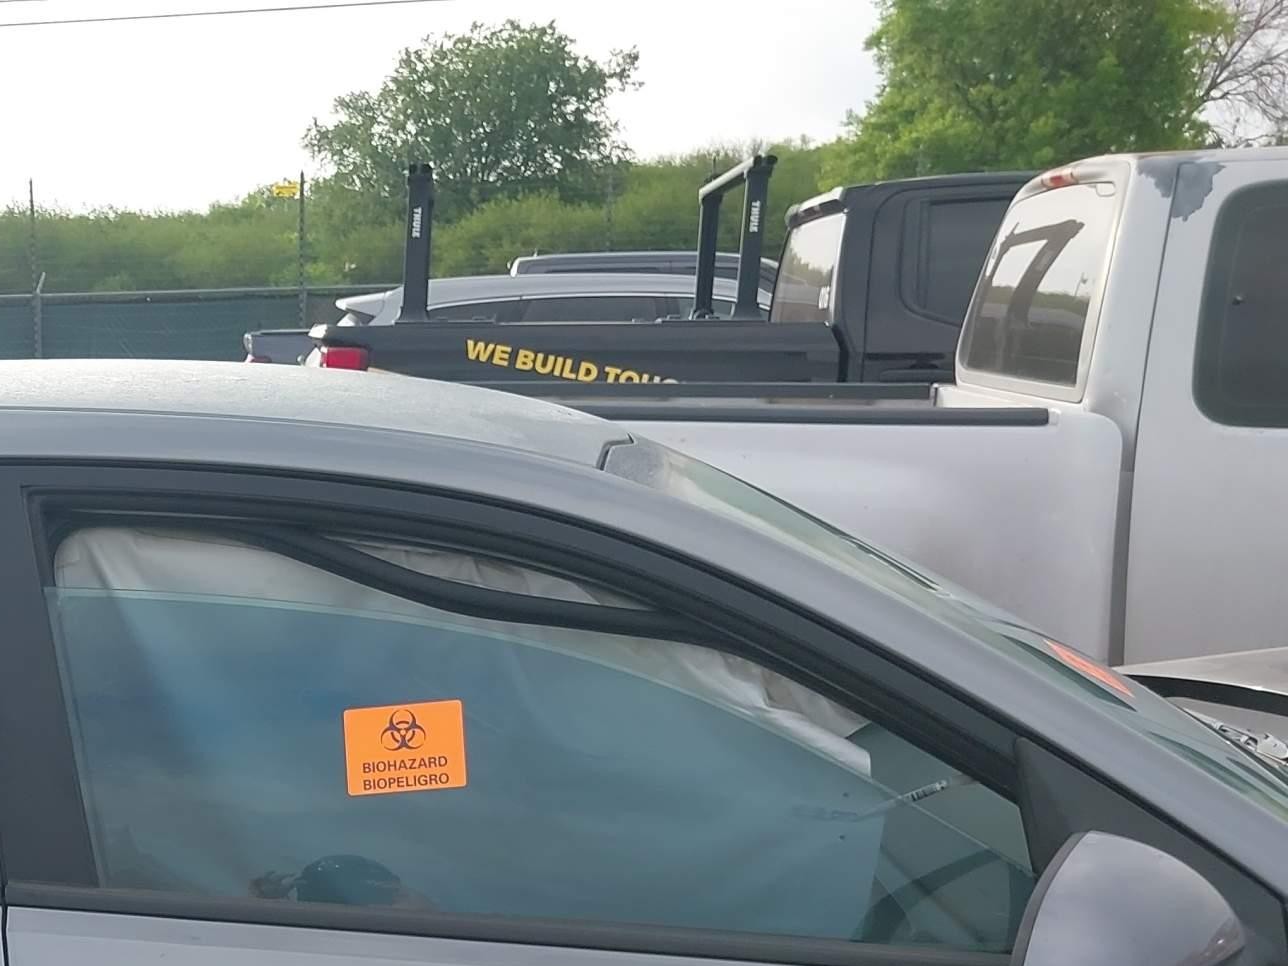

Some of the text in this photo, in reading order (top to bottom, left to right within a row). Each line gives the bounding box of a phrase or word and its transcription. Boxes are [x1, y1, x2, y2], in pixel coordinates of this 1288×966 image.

[412, 207, 422, 238] THULE
[749, 200, 760, 232] THULE
[466, 339, 512, 367] WE
[515, 349, 598, 382] BUILD
[362, 756, 448, 774] BIOHAZARD
[363, 773, 450, 791] BIOPELIGRO
